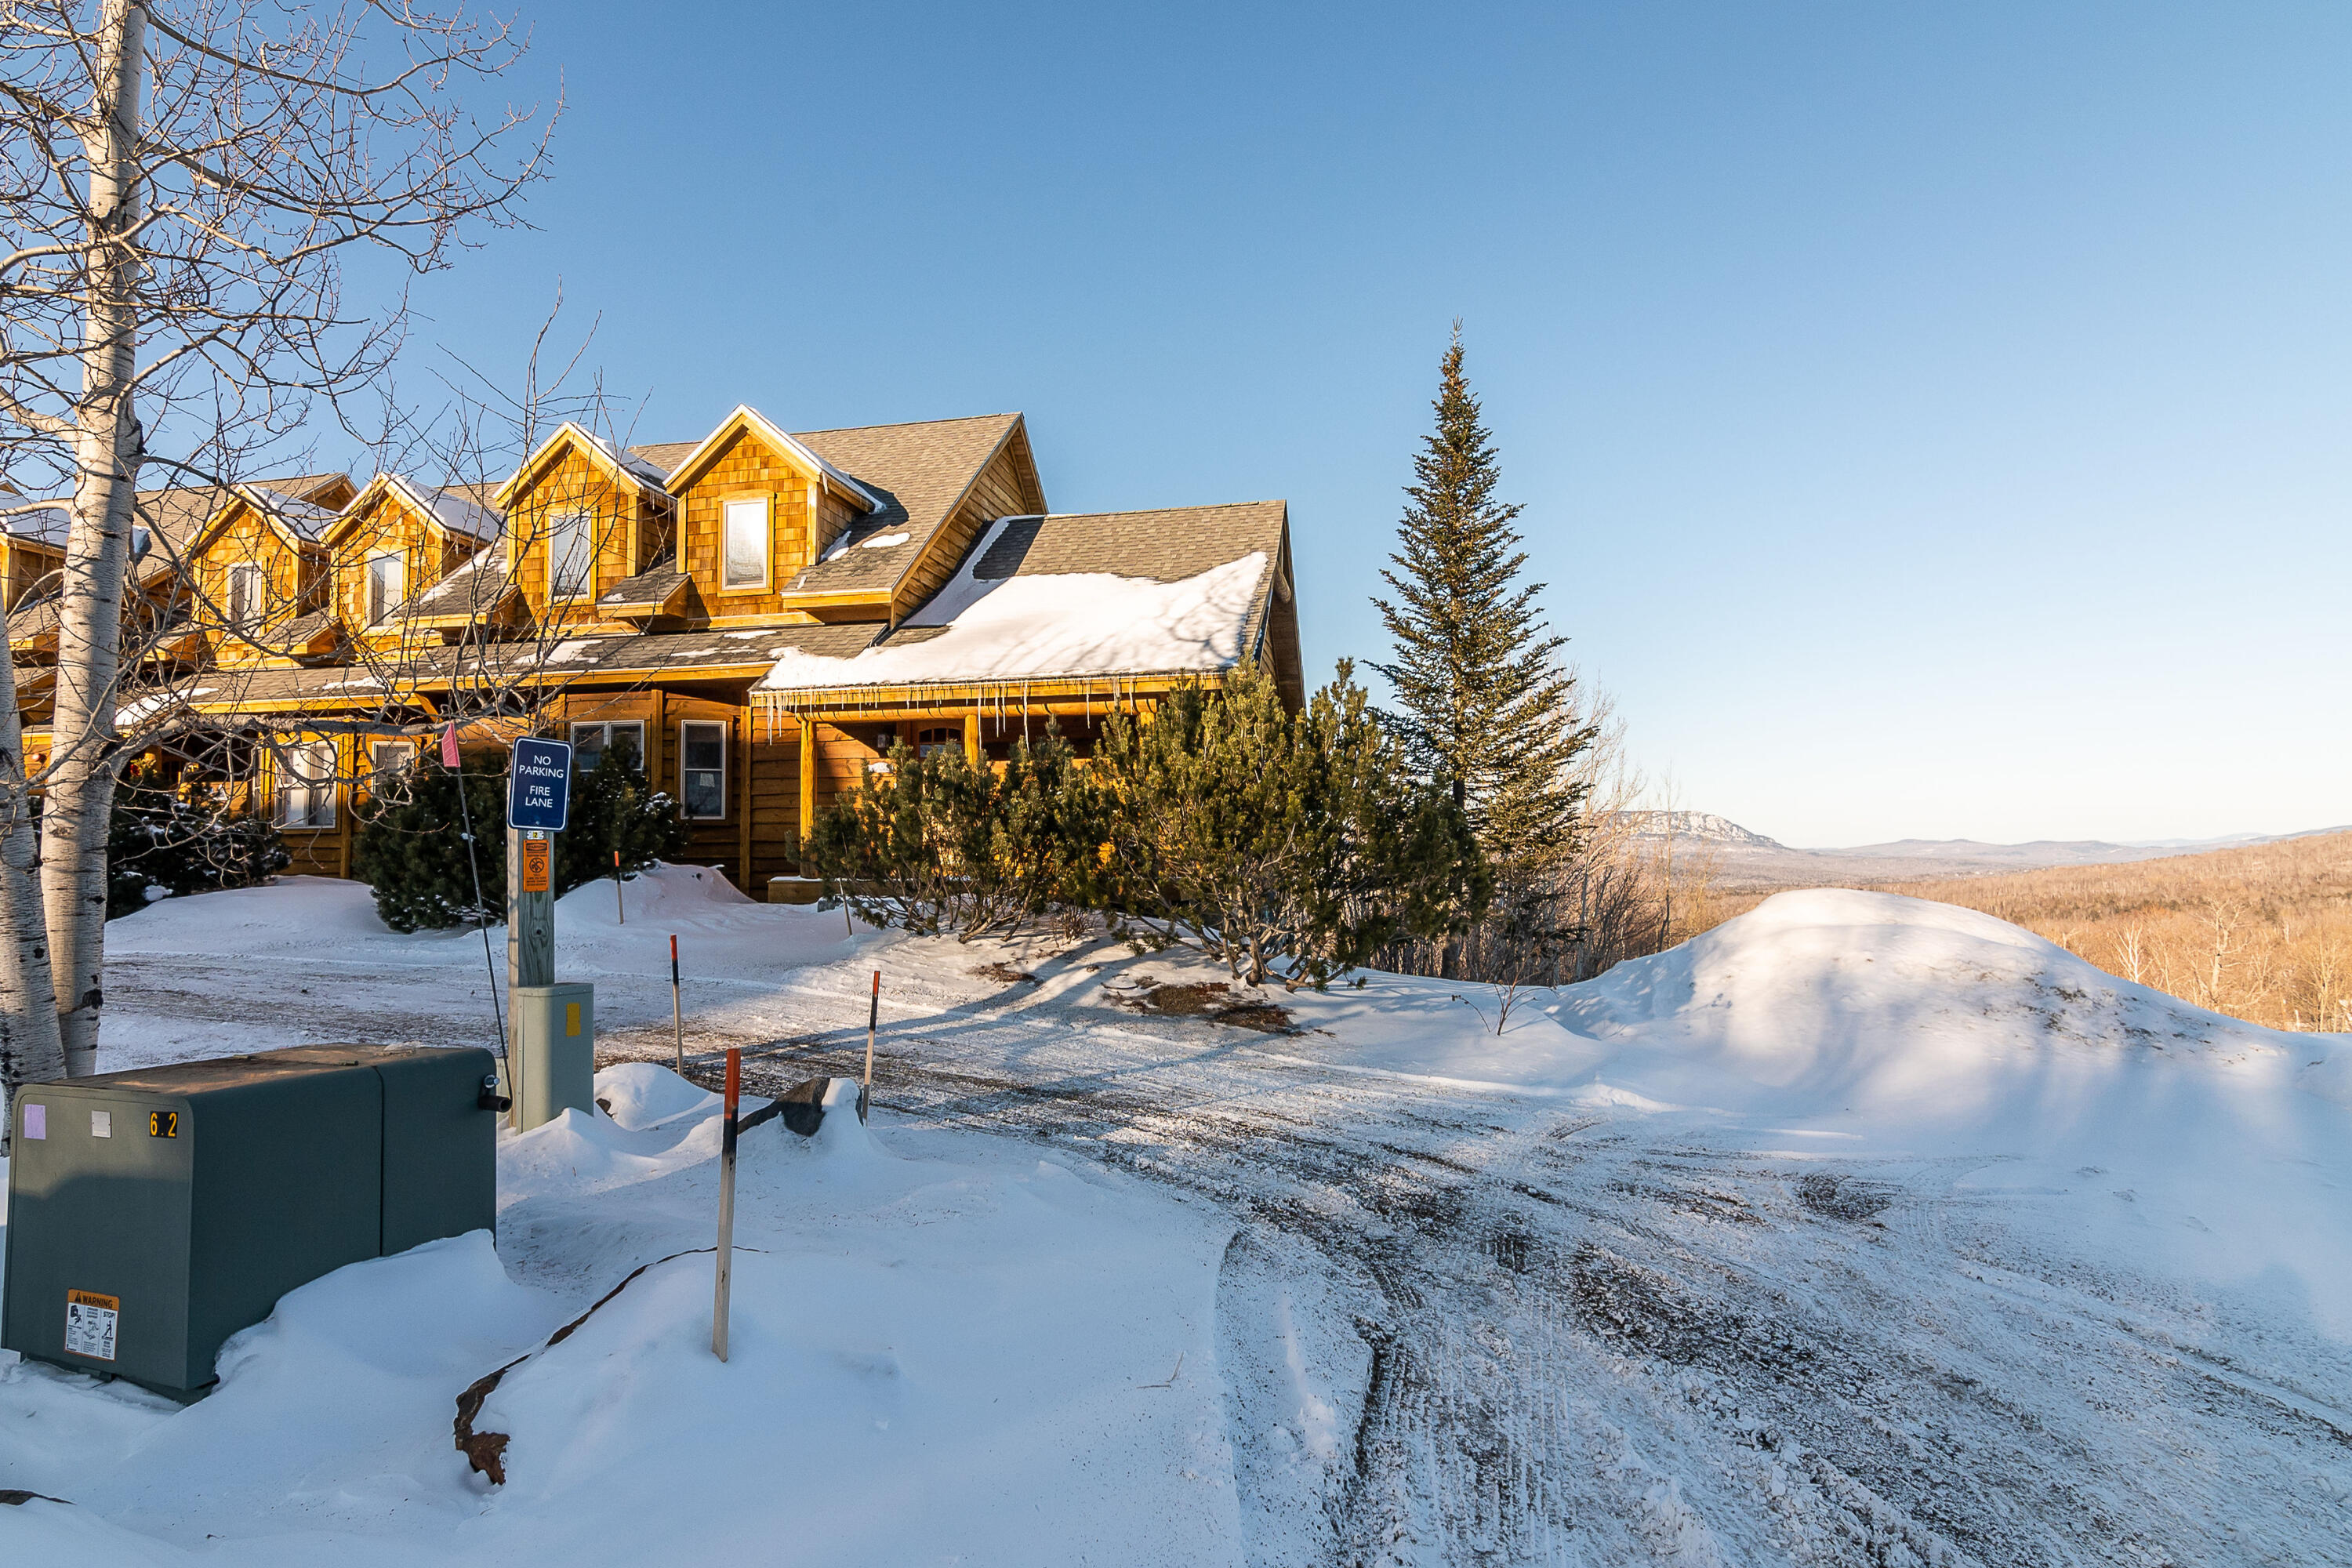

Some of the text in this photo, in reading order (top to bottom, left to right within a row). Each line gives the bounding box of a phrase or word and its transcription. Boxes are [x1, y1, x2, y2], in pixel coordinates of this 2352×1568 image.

[534, 755, 551, 765] NO
[519, 765, 564, 778] PARKING
[530, 786, 550, 796] FIRE
[525, 797, 553, 808] LANE
[83, 1295, 113, 1308] WARNING
